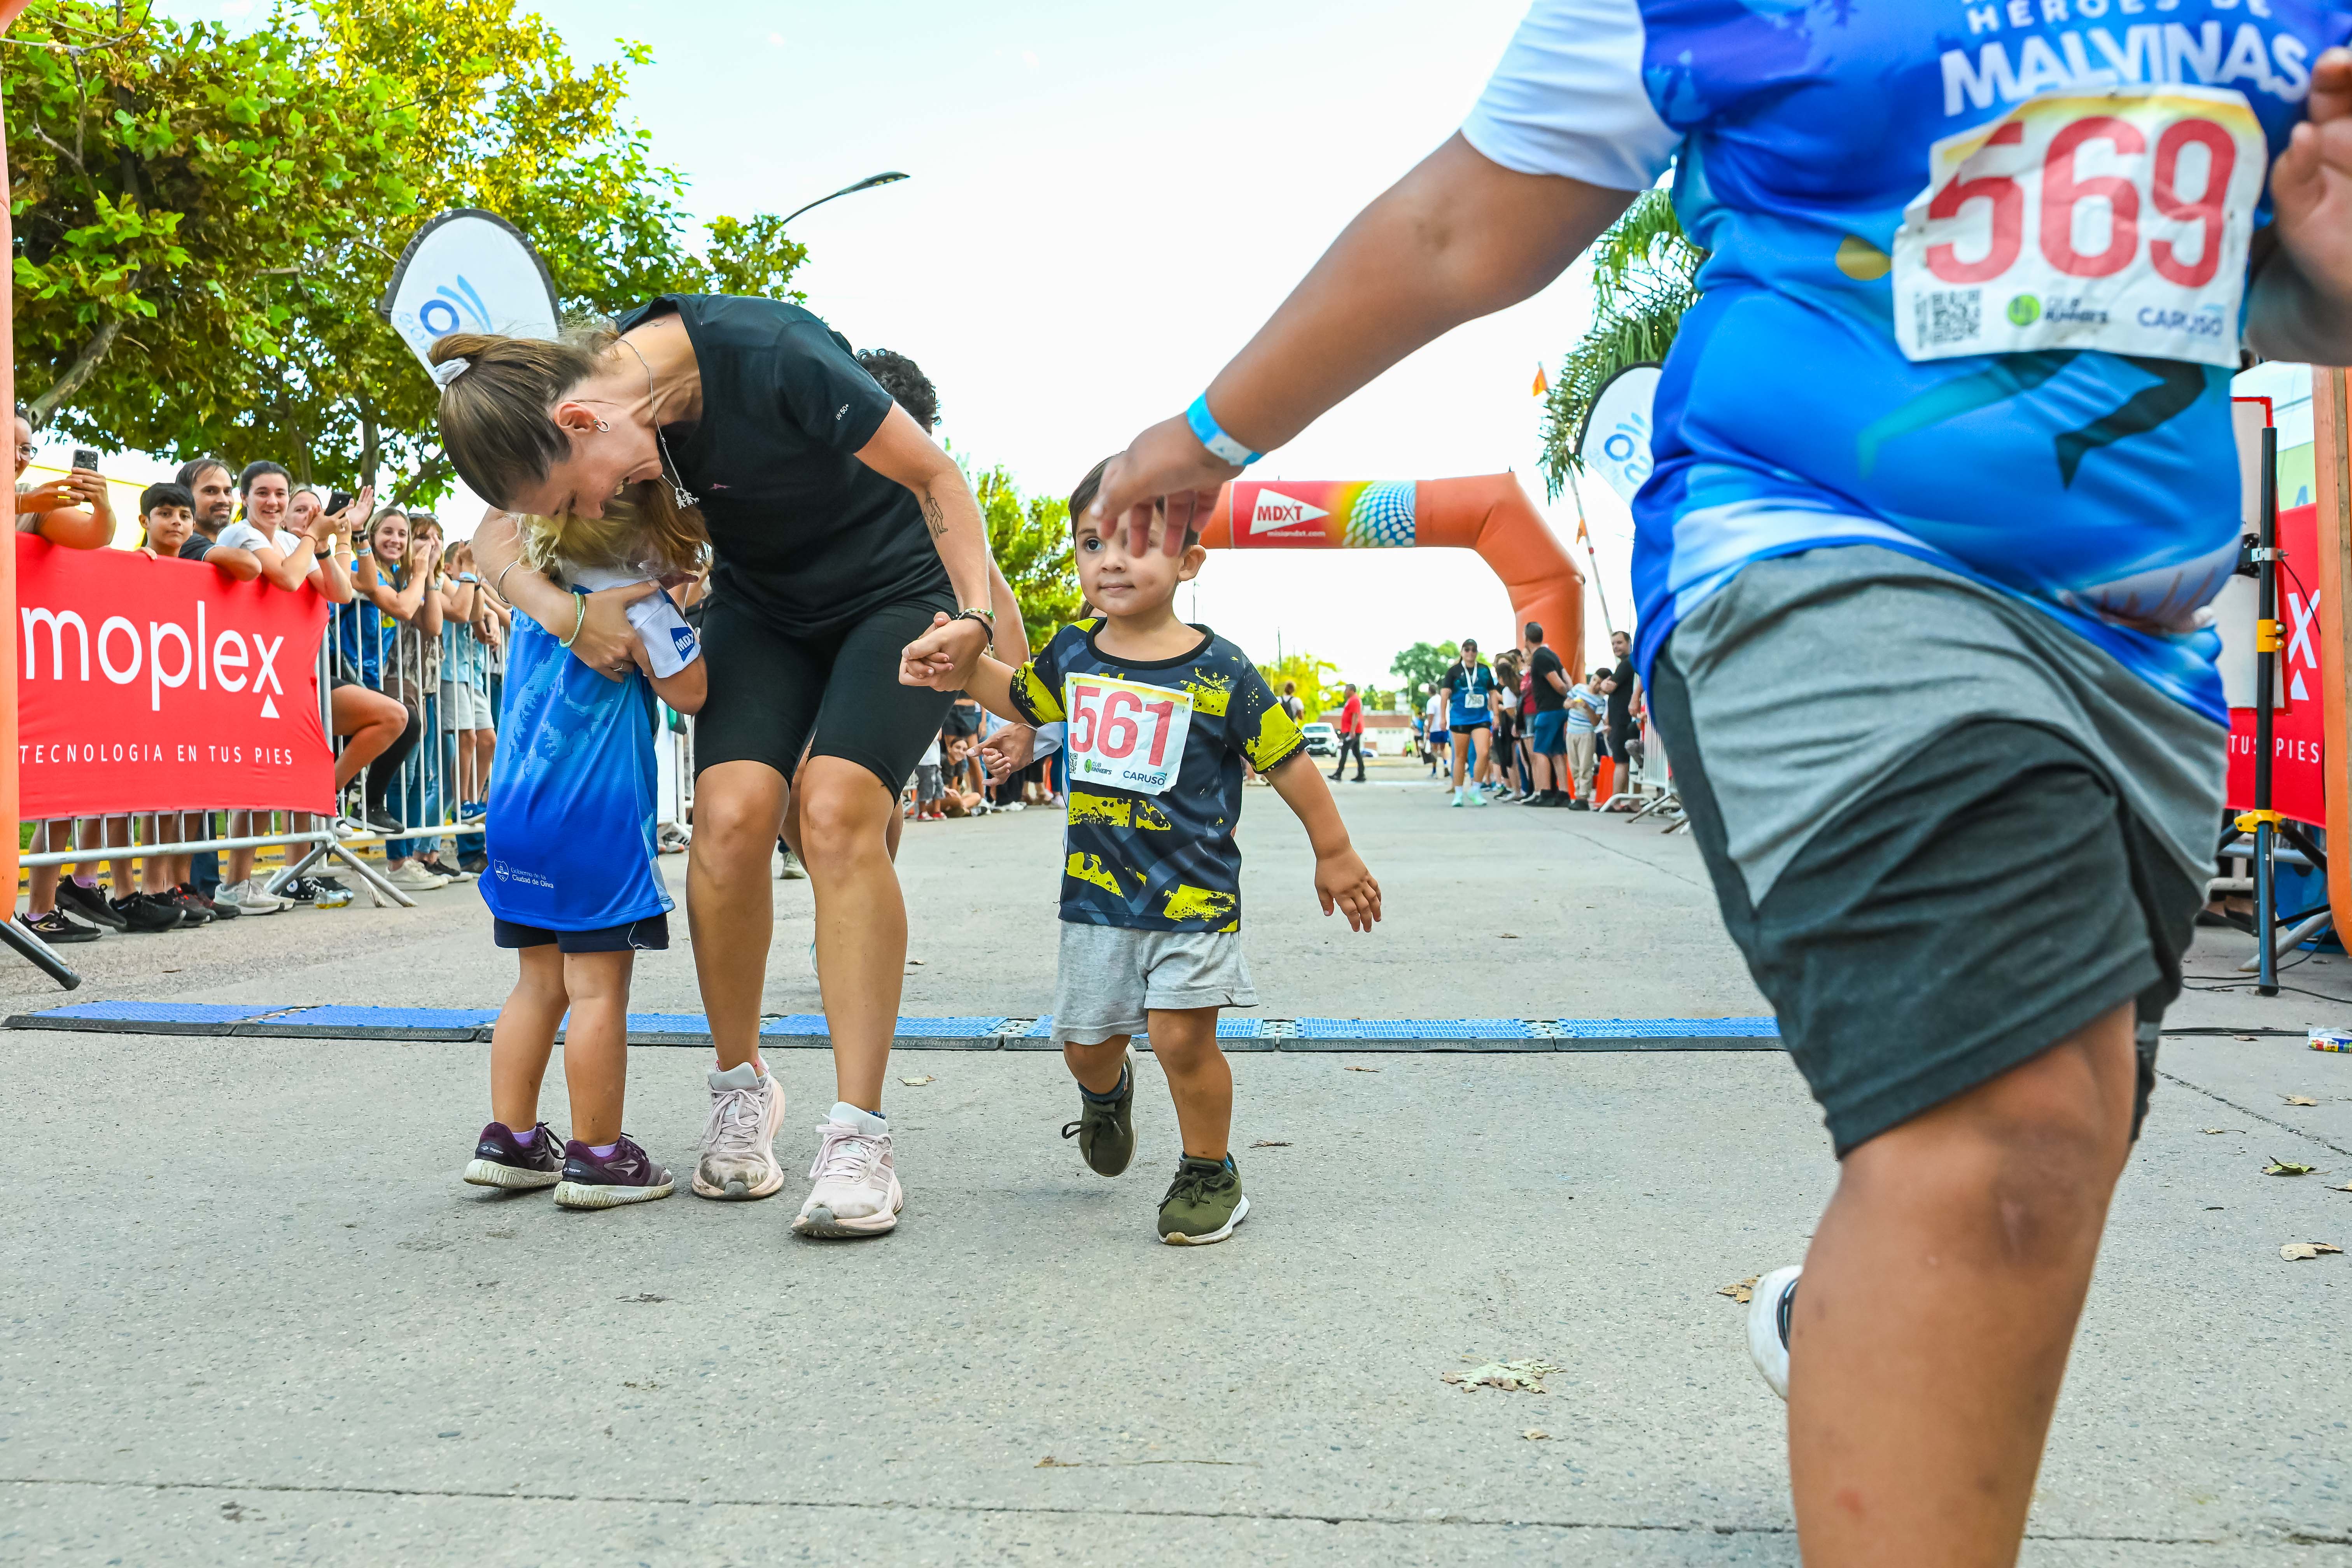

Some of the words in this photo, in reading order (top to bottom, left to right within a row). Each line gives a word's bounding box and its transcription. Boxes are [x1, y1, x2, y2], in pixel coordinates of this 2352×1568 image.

[1941, 21, 2310, 117] MALVINAS
[1926, 116, 2236, 289] 569
[1257, 501, 1303, 523] MDXT
[21, 600, 284, 711] moplex
[1069, 685, 1174, 767] 561
[19, 744, 163, 764] TECNOLOGIA
[177, 745, 196, 762] EN
[208, 746, 242, 763] TUS
[255, 747, 292, 765] PIES
[2230, 735, 2257, 754] TU
[2276, 737, 2319, 764] PIES
[1123, 770, 1165, 786] CARUSO
[512, 874, 531, 884] Ciudad
[540, 880, 554, 889] Oliva
